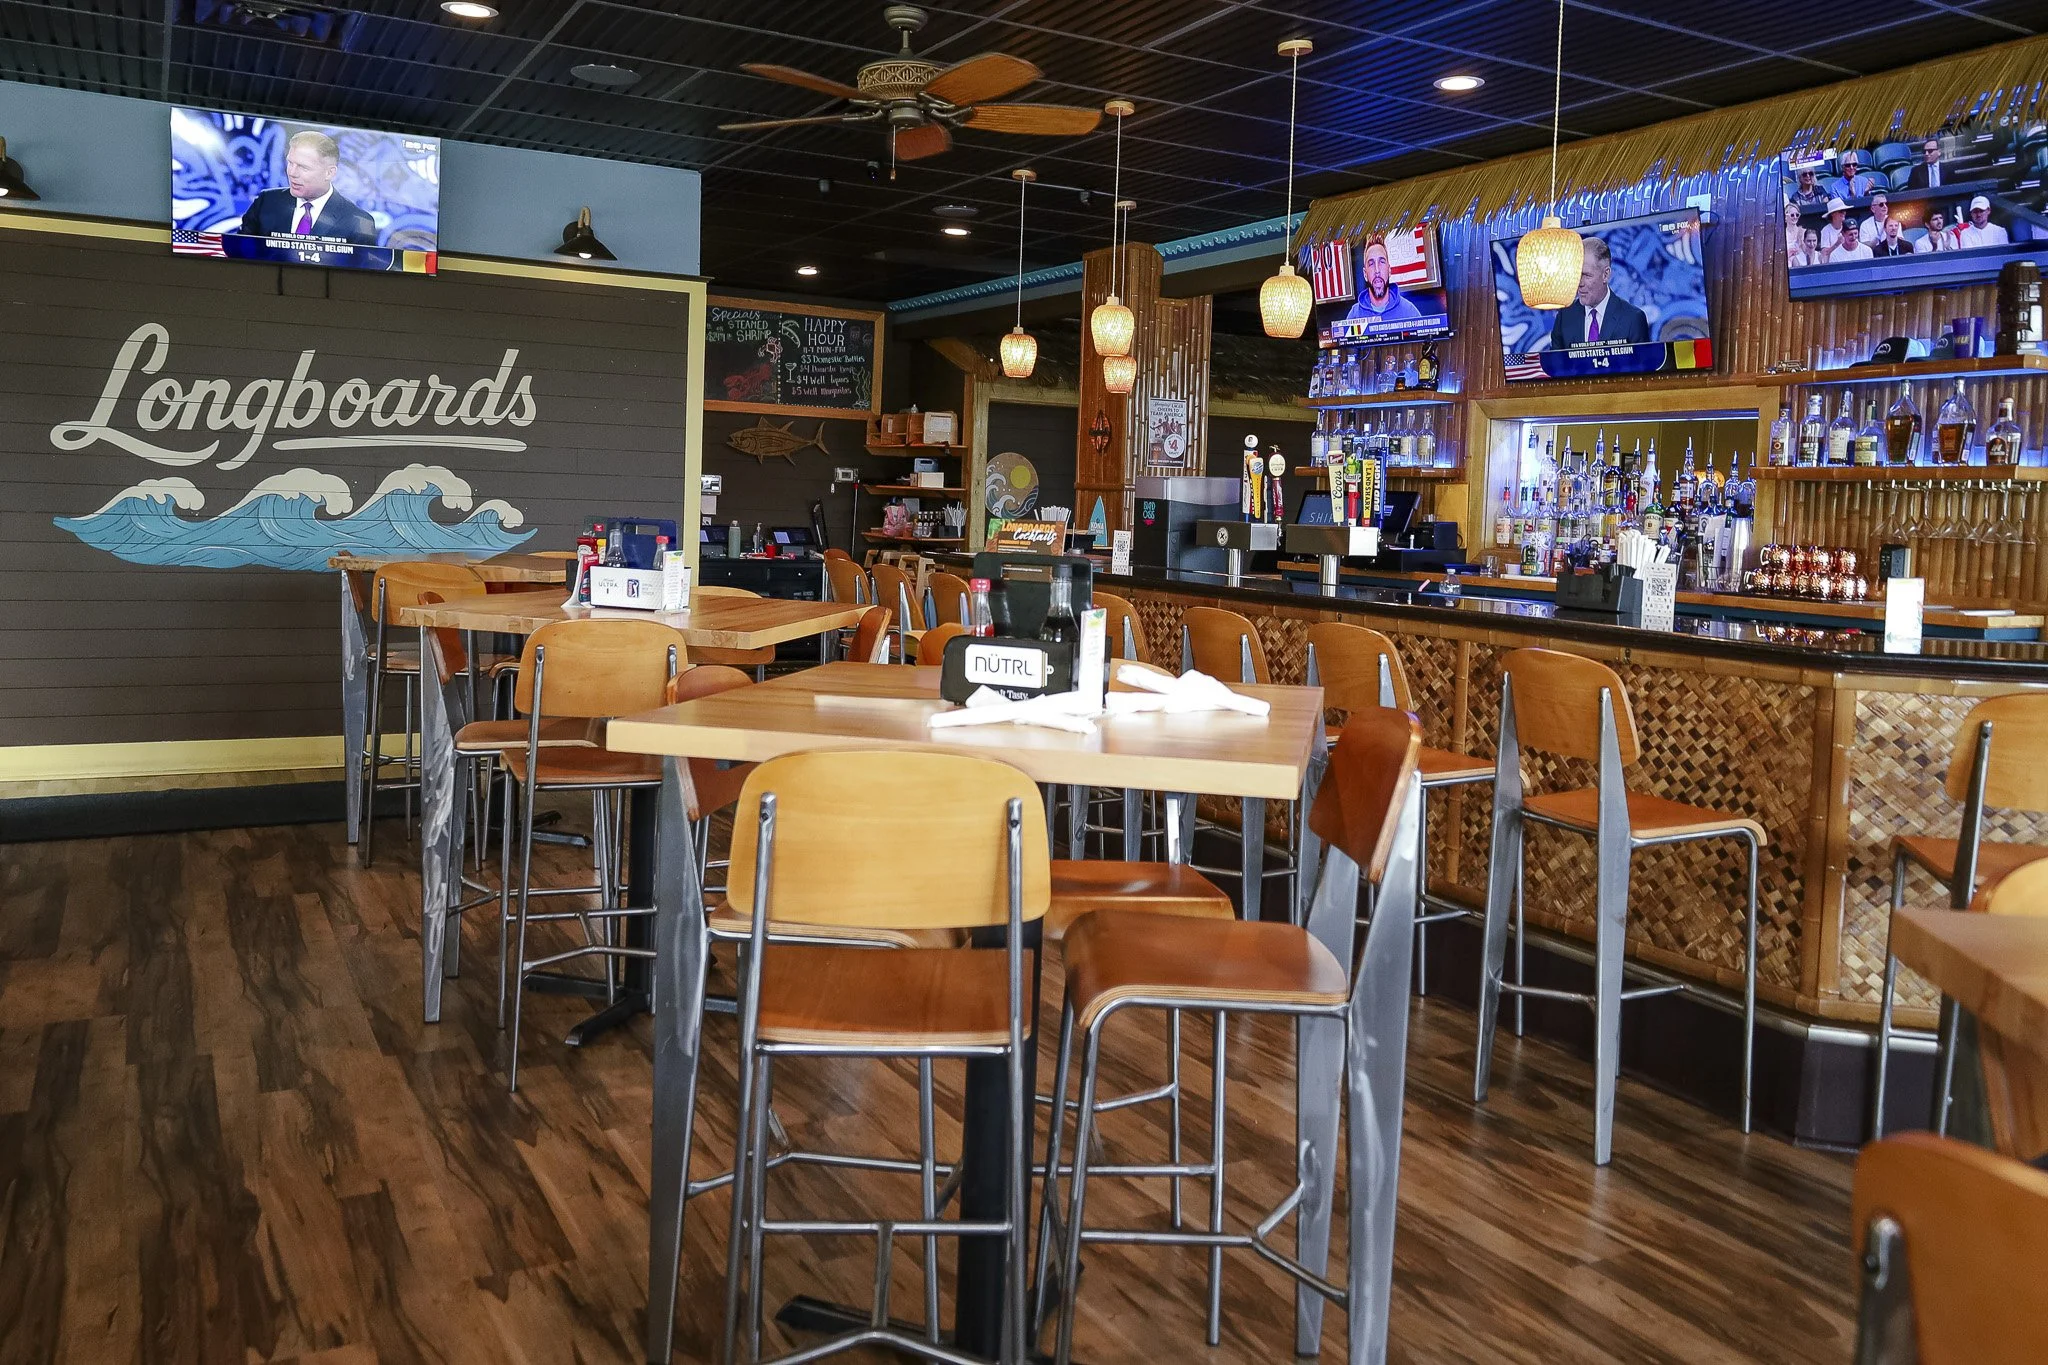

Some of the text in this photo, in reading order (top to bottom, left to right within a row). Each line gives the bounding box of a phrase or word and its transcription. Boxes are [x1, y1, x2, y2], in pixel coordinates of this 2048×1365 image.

[266, 240, 290, 249] UNITED
[290, 241, 317, 251] STATES
[324, 244, 354, 254] BELGIUM
[298, 252, 321, 262] 1-4
[712, 307, 760, 322] Specials
[728, 320, 769, 330] STEAMED
[804, 318, 847, 332] HAPPY
[736, 330, 772, 342] SHRIMP
[808, 333, 845, 346] HOUR
[1568, 350, 1586, 358] UNITED
[1586, 349, 1605, 358] STATES
[1610, 346, 1634, 356] BELGIUM
[812, 354, 842, 364] Domestic
[796, 374, 808, 384] $4
[810, 375, 826, 384] Well
[50, 322, 536, 470] Longboards
[1332, 470, 1343, 500] Coors
[1002, 522, 1056, 533] LONGBOARDS
[1013, 528, 1058, 546] Cocktails
[1007, 690, 1029, 700] Tasty.
